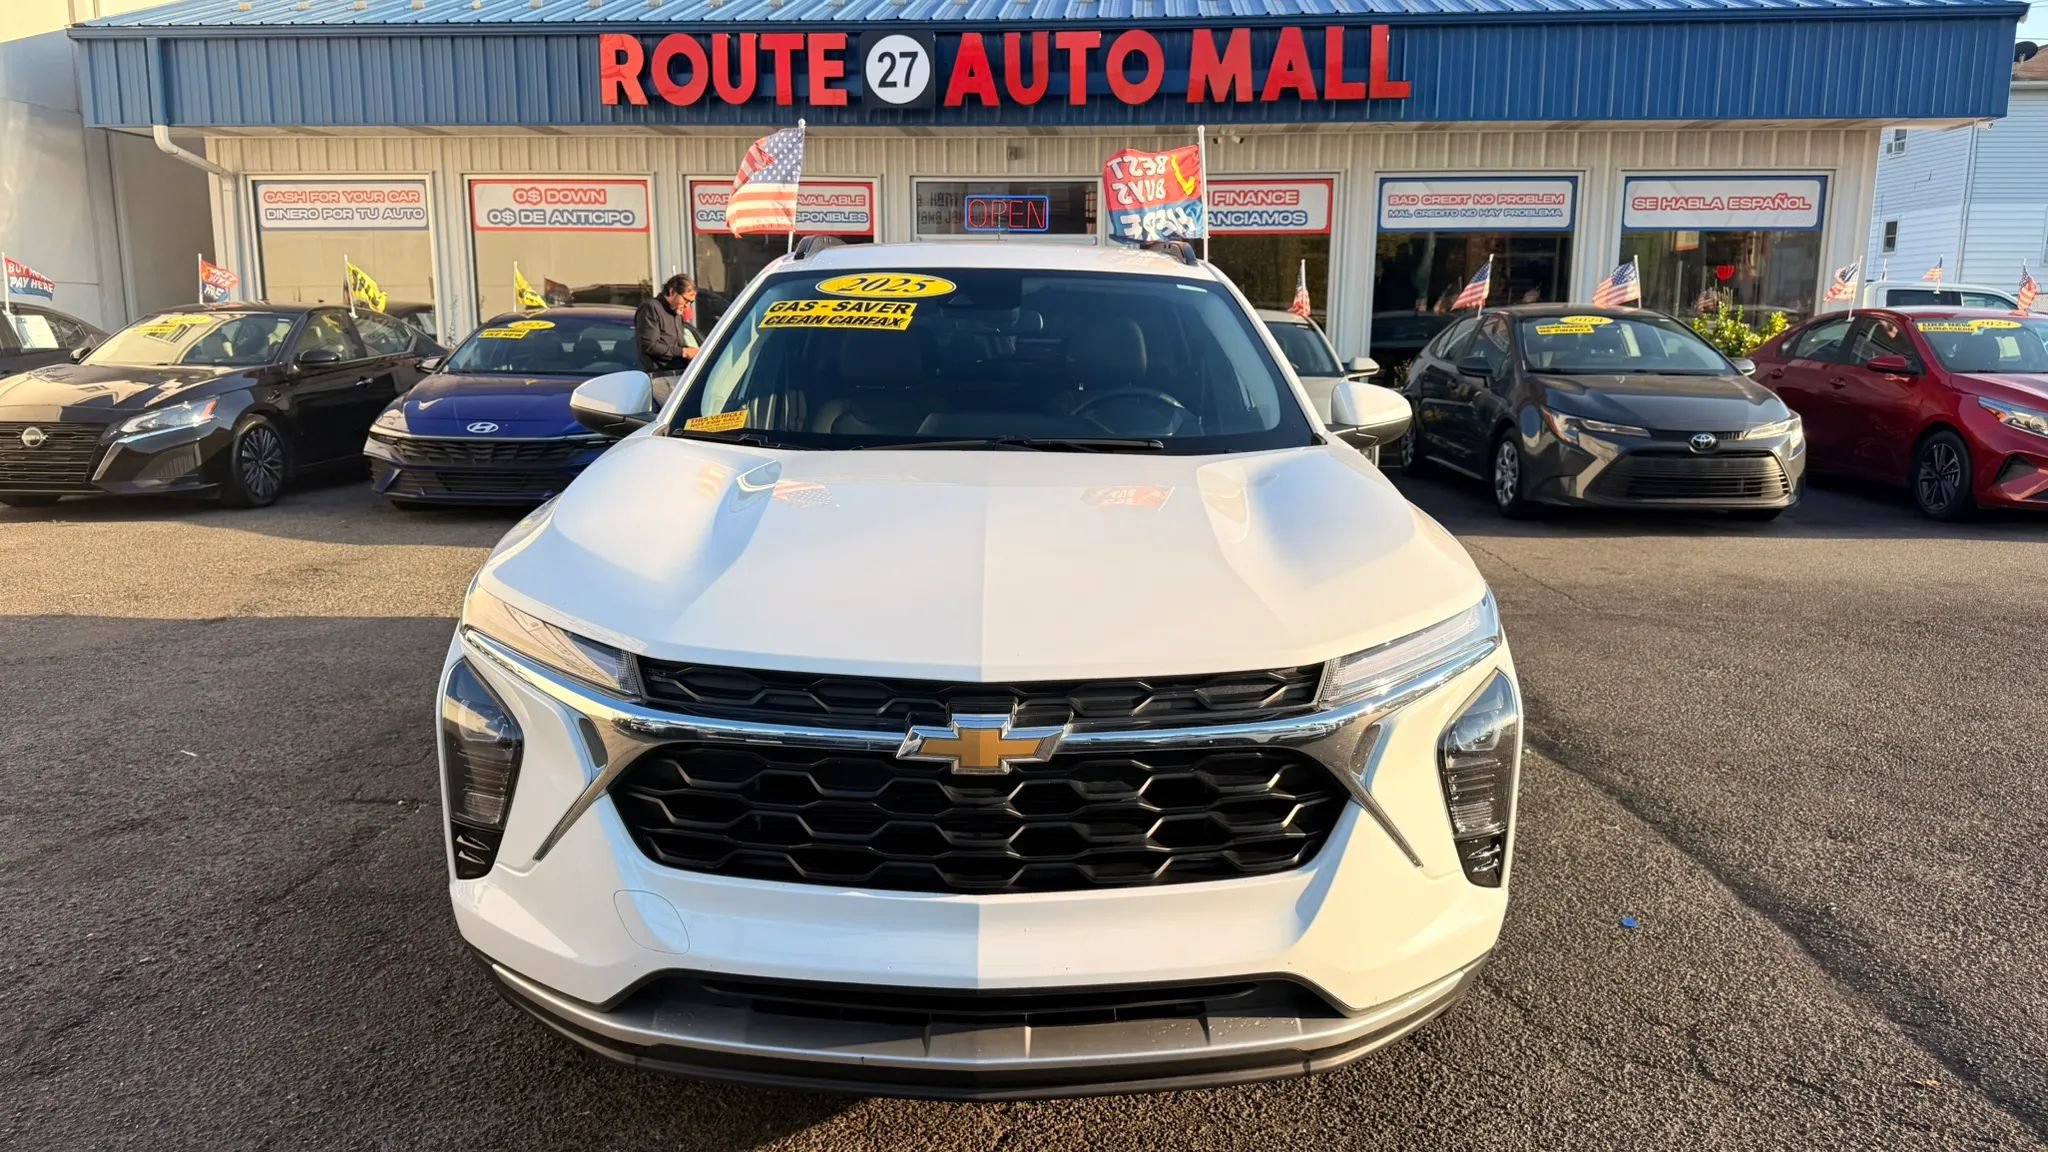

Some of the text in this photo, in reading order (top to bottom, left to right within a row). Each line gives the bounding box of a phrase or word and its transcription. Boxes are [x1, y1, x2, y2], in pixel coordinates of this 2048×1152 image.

[600, 25, 1411, 107] ROUTE 27 AUTO MALL
[264, 190, 420, 204] CASH FOR YOUR CAR
[545, 188, 607, 205] DOWN
[1213, 190, 1300, 206] FINANCE
[1388, 193, 1565, 206] BAD CREDIT NO PROBLEM
[1632, 193, 1811, 211] SE HABLA ESPAÑOL
[265, 207, 425, 220] DINERO POR TU AUTO
[519, 209, 546, 225] DE
[548, 209, 635, 226] ANTICIPO
[968, 199, 1046, 229] OPEN
[1388, 208, 1563, 218] MAL CREDITO NO HAY PROBLEMA
[8, 262, 27, 274] BUY
[10, 276, 54, 293] PAY HERE
[838, 277, 936, 293] 2025
[769, 301, 816, 313] GAS
[832, 302, 911, 314] SAVER
[764, 314, 906, 327] CLEAN CARFAX
[711, 411, 744, 420] VEHICLE
